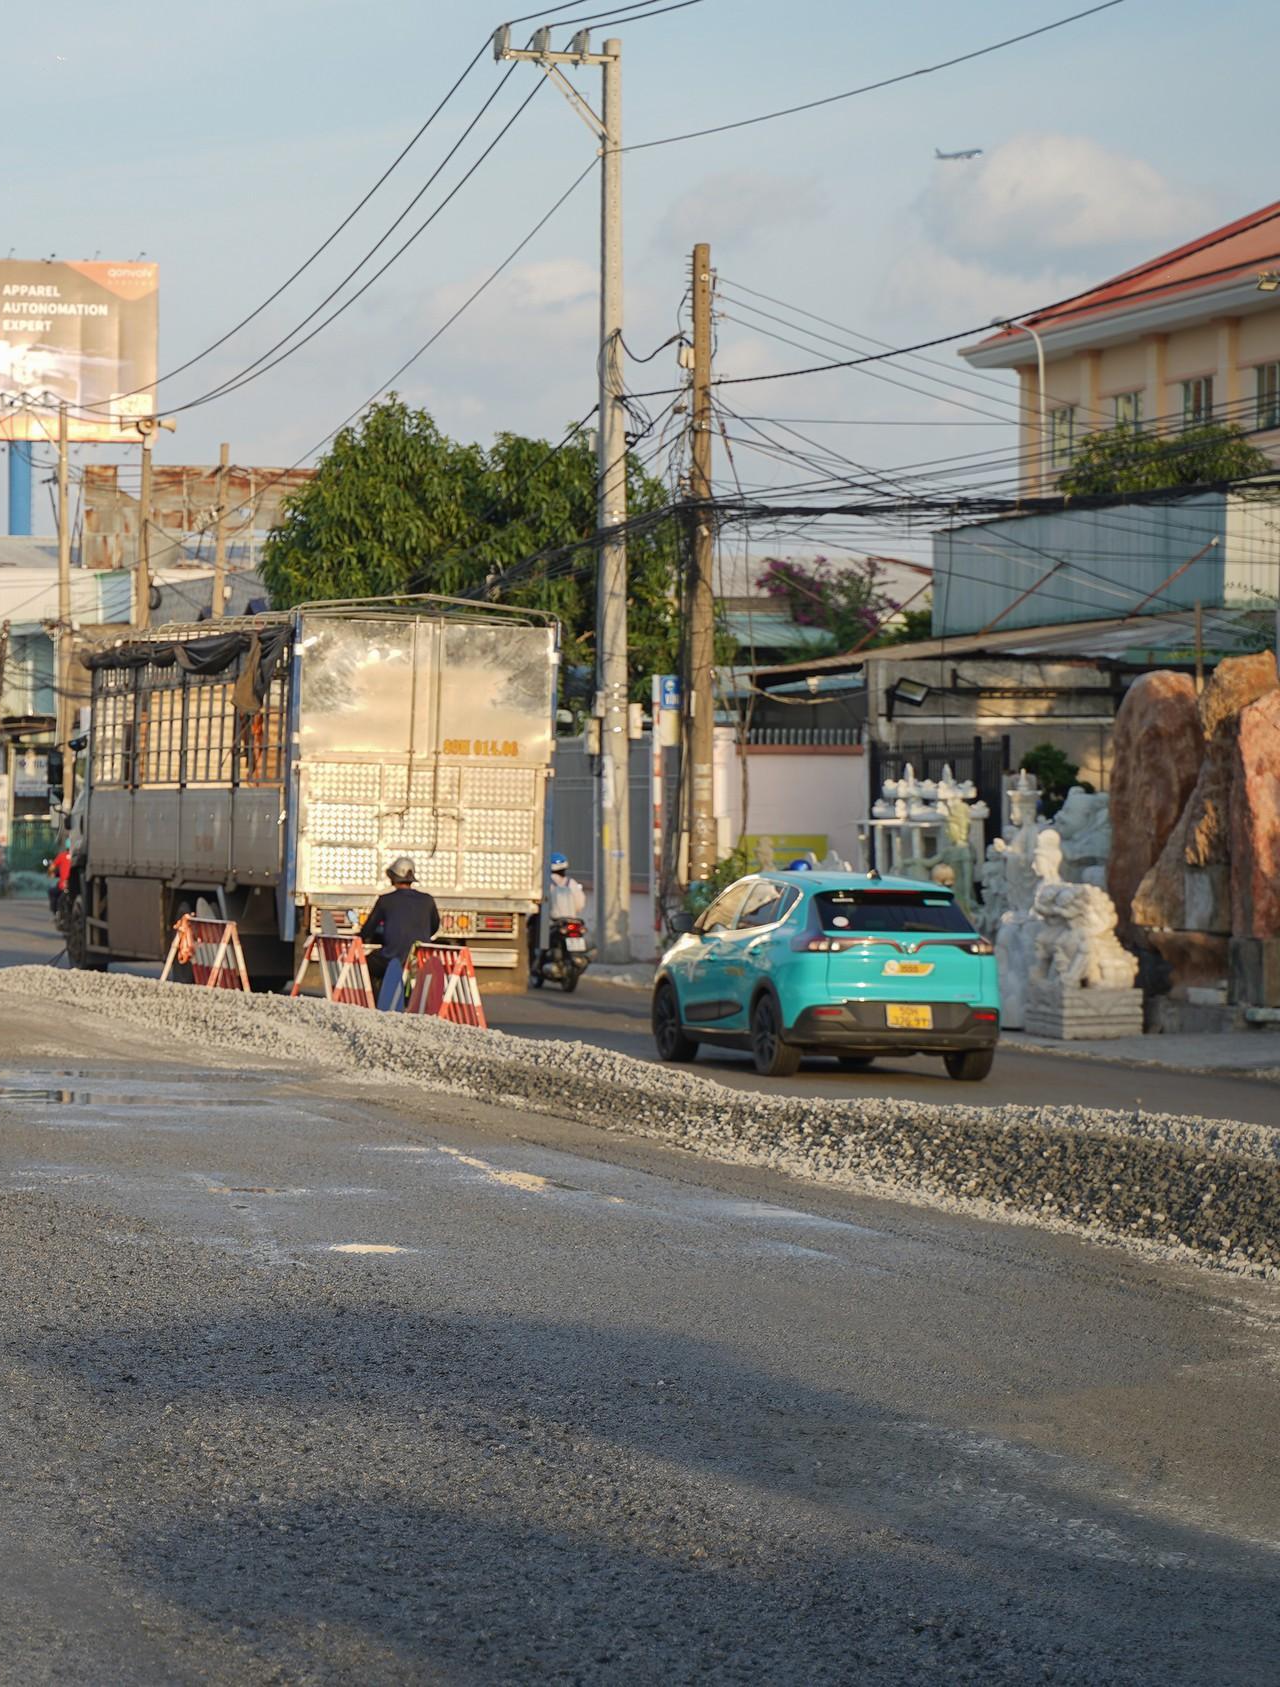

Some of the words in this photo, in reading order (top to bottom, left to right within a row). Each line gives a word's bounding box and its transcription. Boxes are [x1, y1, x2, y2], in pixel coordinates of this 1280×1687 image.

[2, 284, 61, 298] APPAREL
[2, 302, 109, 316] AUTONOMATION
[2, 319, 53, 332] EXPERT
